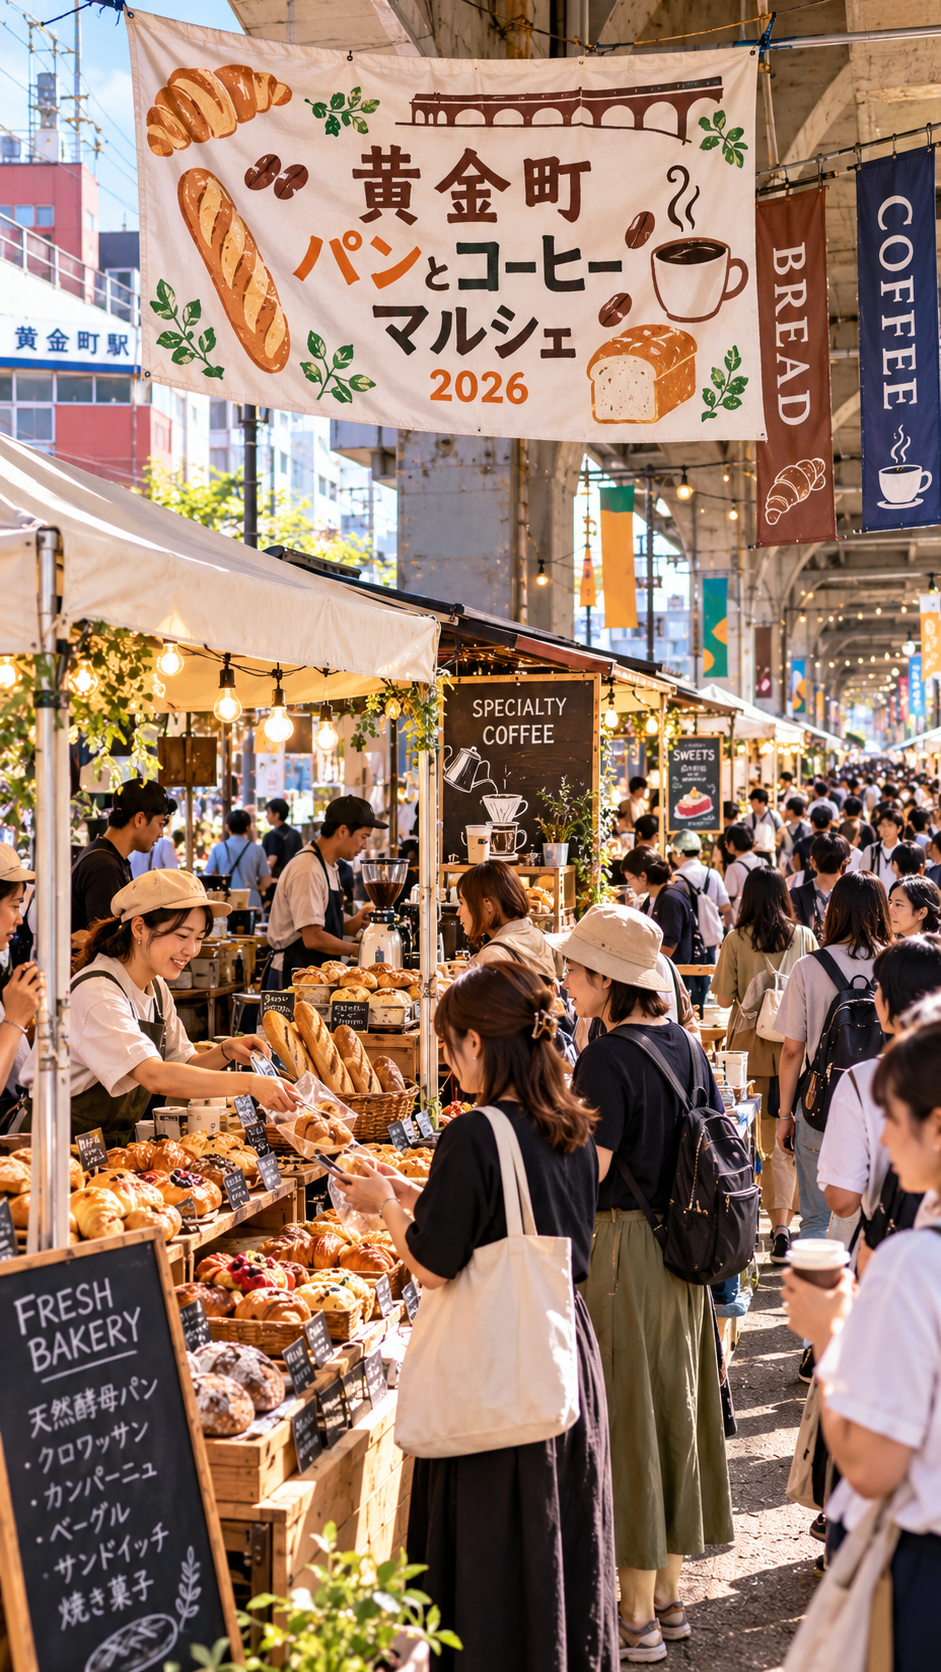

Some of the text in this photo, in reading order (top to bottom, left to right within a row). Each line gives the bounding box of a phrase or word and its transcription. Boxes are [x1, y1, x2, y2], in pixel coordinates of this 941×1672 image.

[352, 144, 591, 225] 黄金町
[292, 229, 624, 292] パンとコーヒー
[372, 304, 576, 359] マルシェ
[876, 195, 918, 410] COFFEE
[15, 325, 130, 357] 黄金町駅
[772, 241, 811, 426] BREAD
[429, 368, 529, 405] 2026
[472, 697, 567, 718] SPECIALTY
[482, 724, 555, 745] COFFEE
[673, 749, 715, 761] SWEETS
[13, 1277, 114, 1336] FRESH
[27, 1306, 141, 1373] BAKERY
[27, 1376, 158, 1438] 天然酵母パン
[57, 1570, 155, 1631] 焼き菓子
